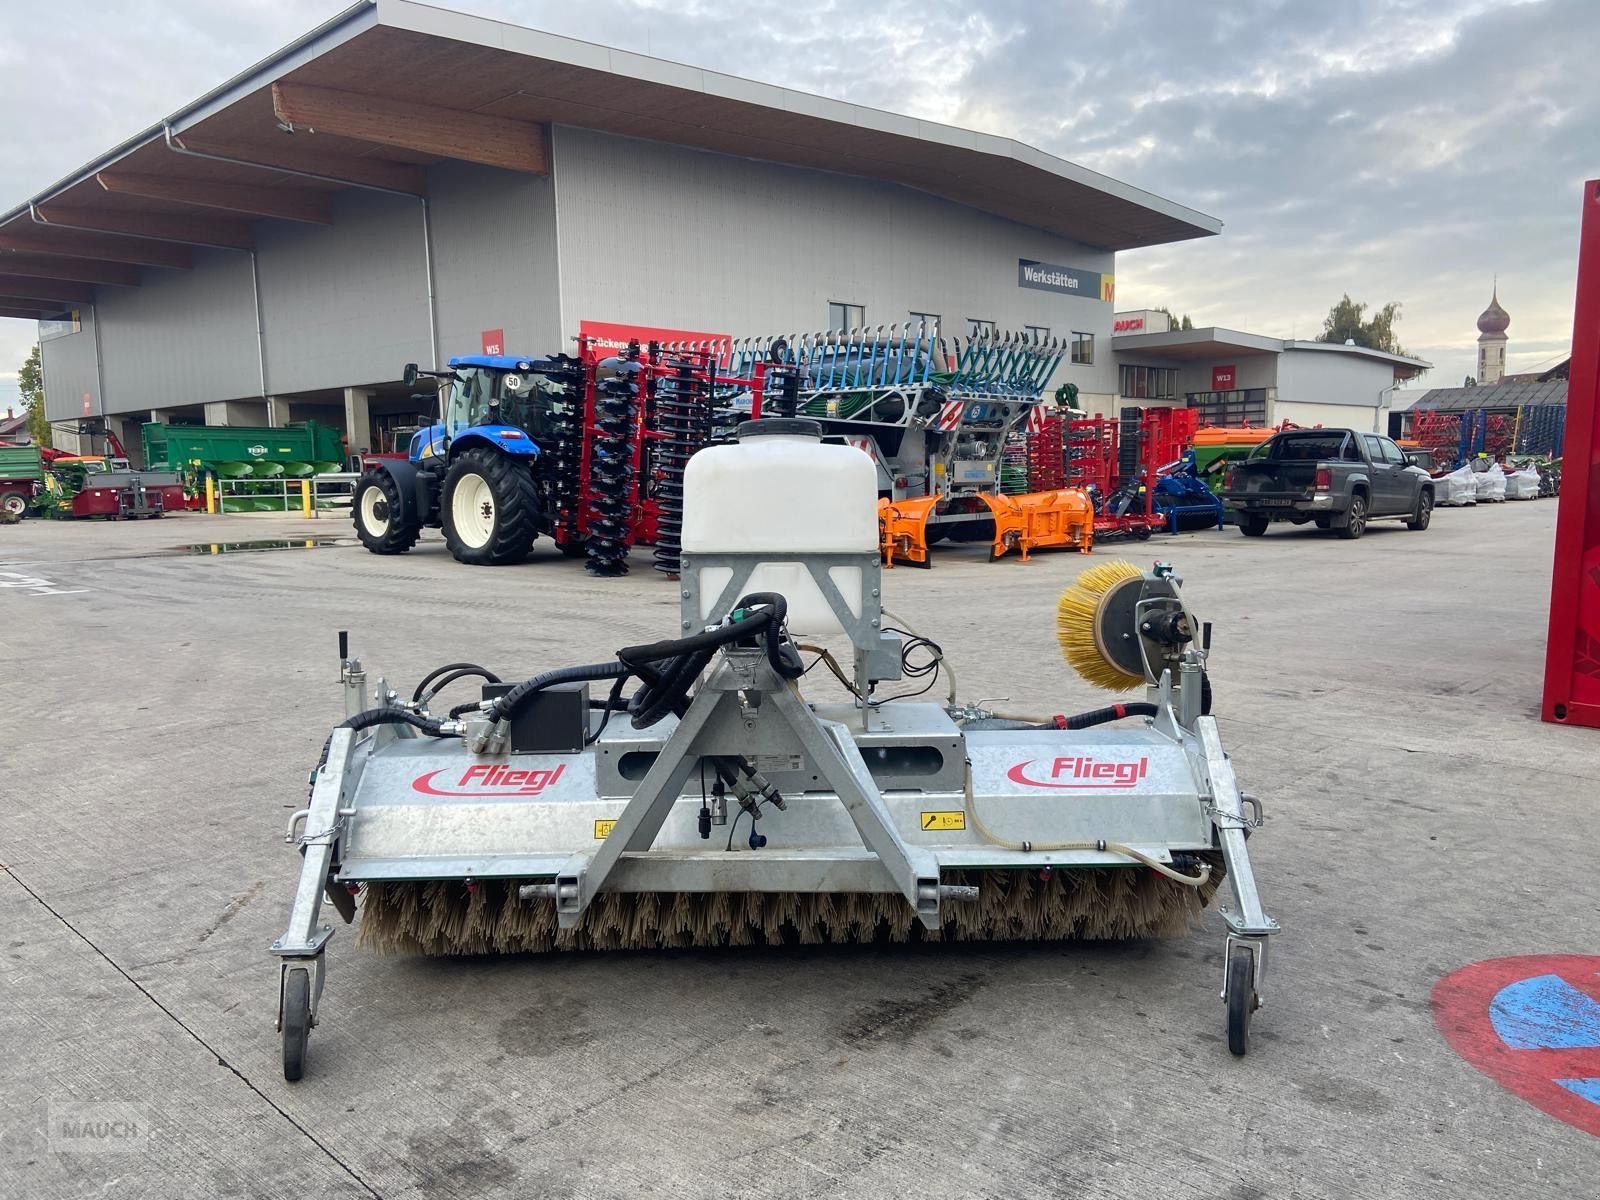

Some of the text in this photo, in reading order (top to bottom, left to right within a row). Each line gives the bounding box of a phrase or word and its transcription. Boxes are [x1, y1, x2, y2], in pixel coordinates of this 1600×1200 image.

[1024, 266, 1079, 289] Werkstätten
[1113, 318, 1144, 331] AUCH
[486, 344, 500, 355] W15
[508, 377, 518, 387] 50
[457, 763, 567, 792] Fliegl
[1051, 757, 1149, 784] Fliegl
